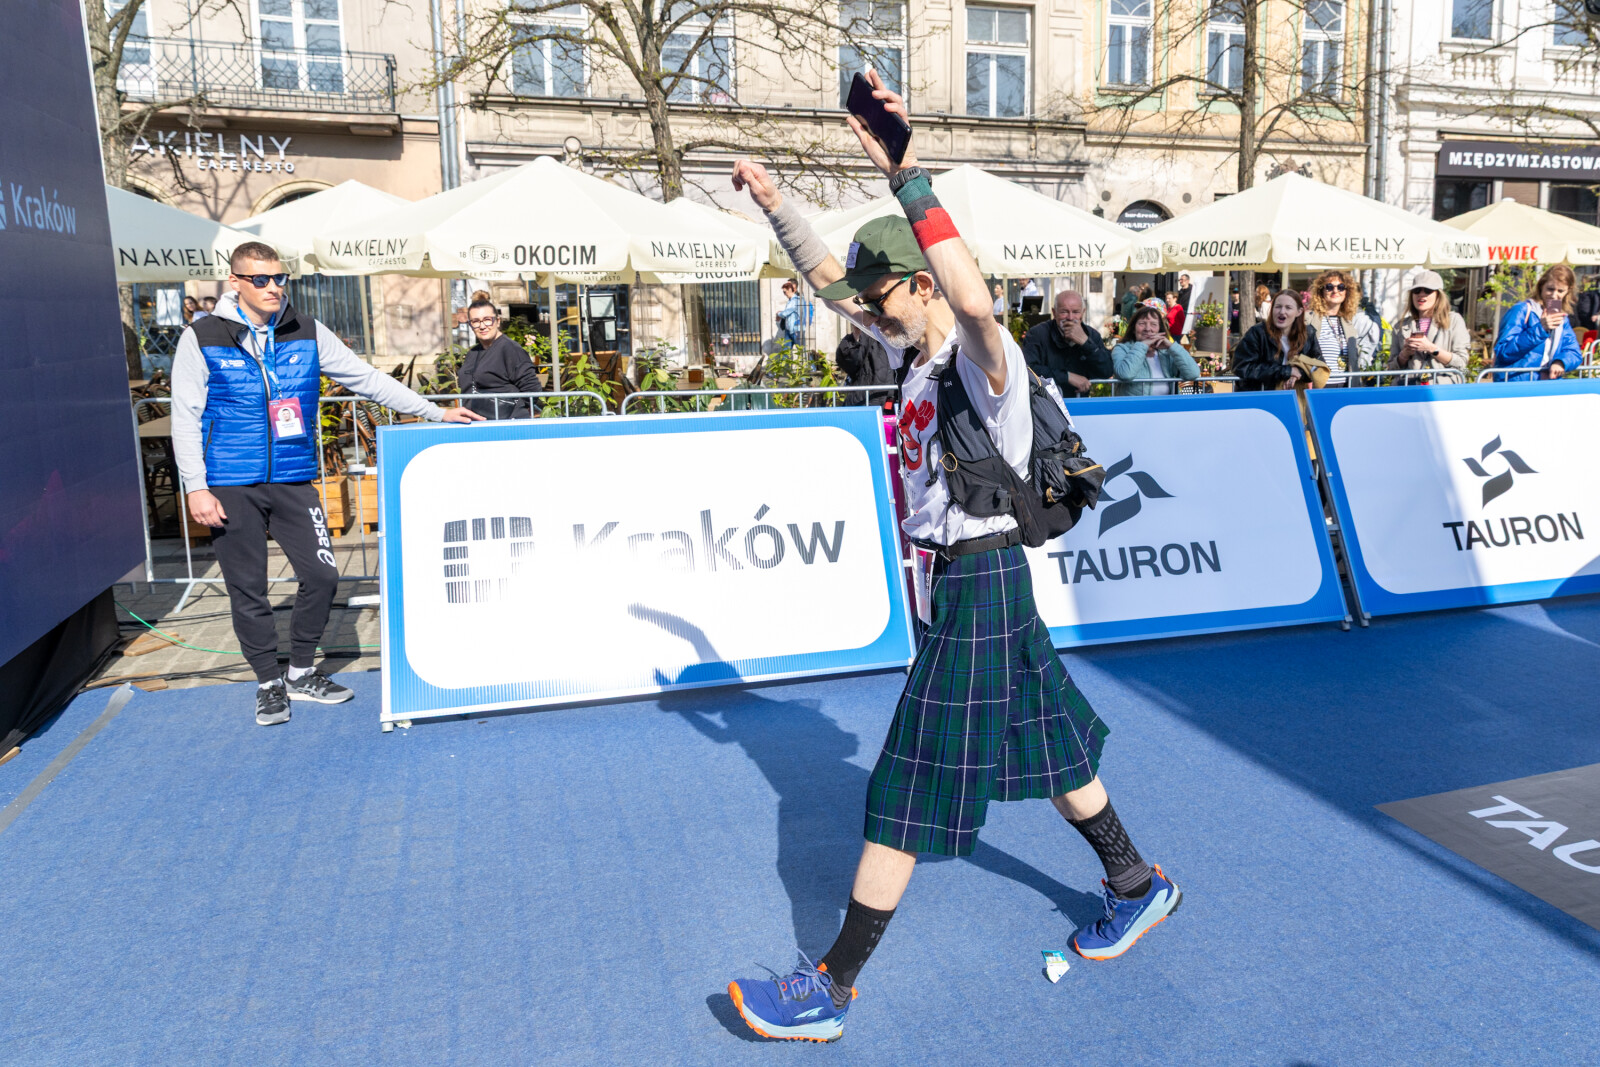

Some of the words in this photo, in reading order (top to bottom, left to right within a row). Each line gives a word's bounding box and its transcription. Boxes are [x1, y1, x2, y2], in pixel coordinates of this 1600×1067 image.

[130, 130, 293, 162] AKIELNY
[10, 181, 77, 235] Kraków
[329, 238, 408, 257] NAKIELNY
[651, 241, 736, 259] NAKIELNY
[1003, 243, 1106, 260] NAKIELNY
[1189, 240, 1248, 258] OKOCIM
[1297, 237, 1405, 252] NAKIELNY
[1488, 245, 1540, 261] YWIEC
[118, 247, 231, 267] NAKIELN
[513, 244, 597, 266] OKOCIM
[1442, 511, 1585, 552] TAURON
[1048, 540, 1222, 585] TAURON
